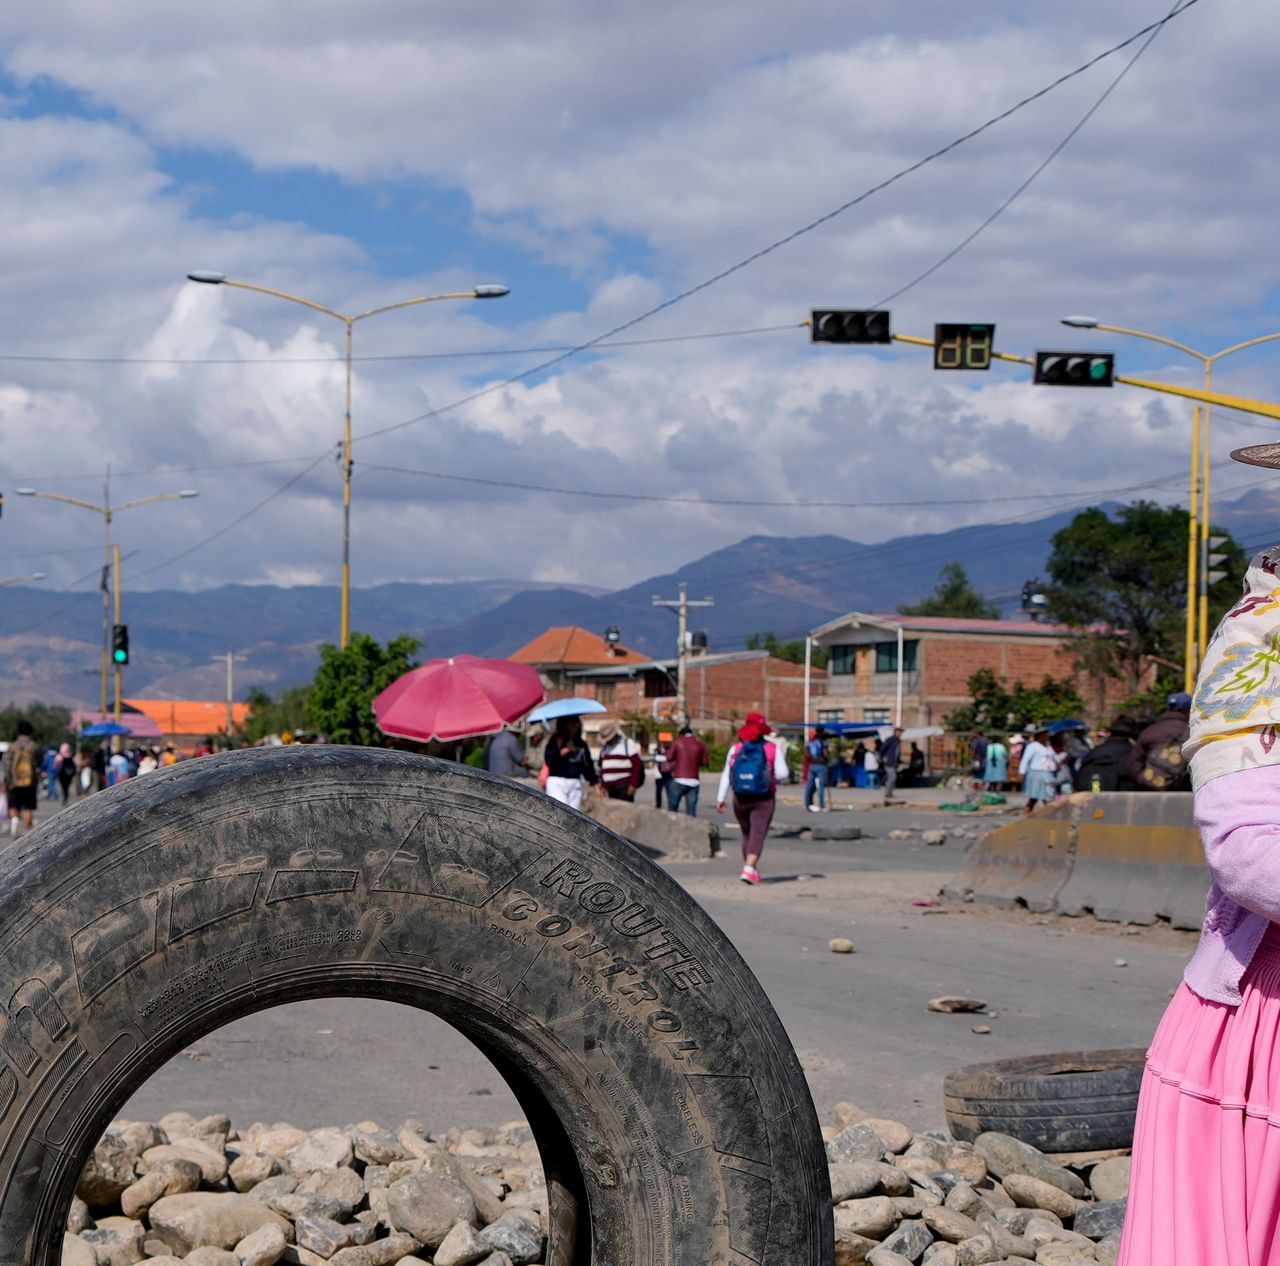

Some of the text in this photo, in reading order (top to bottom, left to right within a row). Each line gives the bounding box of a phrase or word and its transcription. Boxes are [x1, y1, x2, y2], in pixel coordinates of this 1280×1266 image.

[489, 923, 528, 948] RADIAL
[539, 858, 712, 992] ROUTE
[502, 890, 699, 1062] CONTROL
[579, 974, 645, 1040] REGROOVABLE
[674, 1090, 704, 1147] TUBELESS
